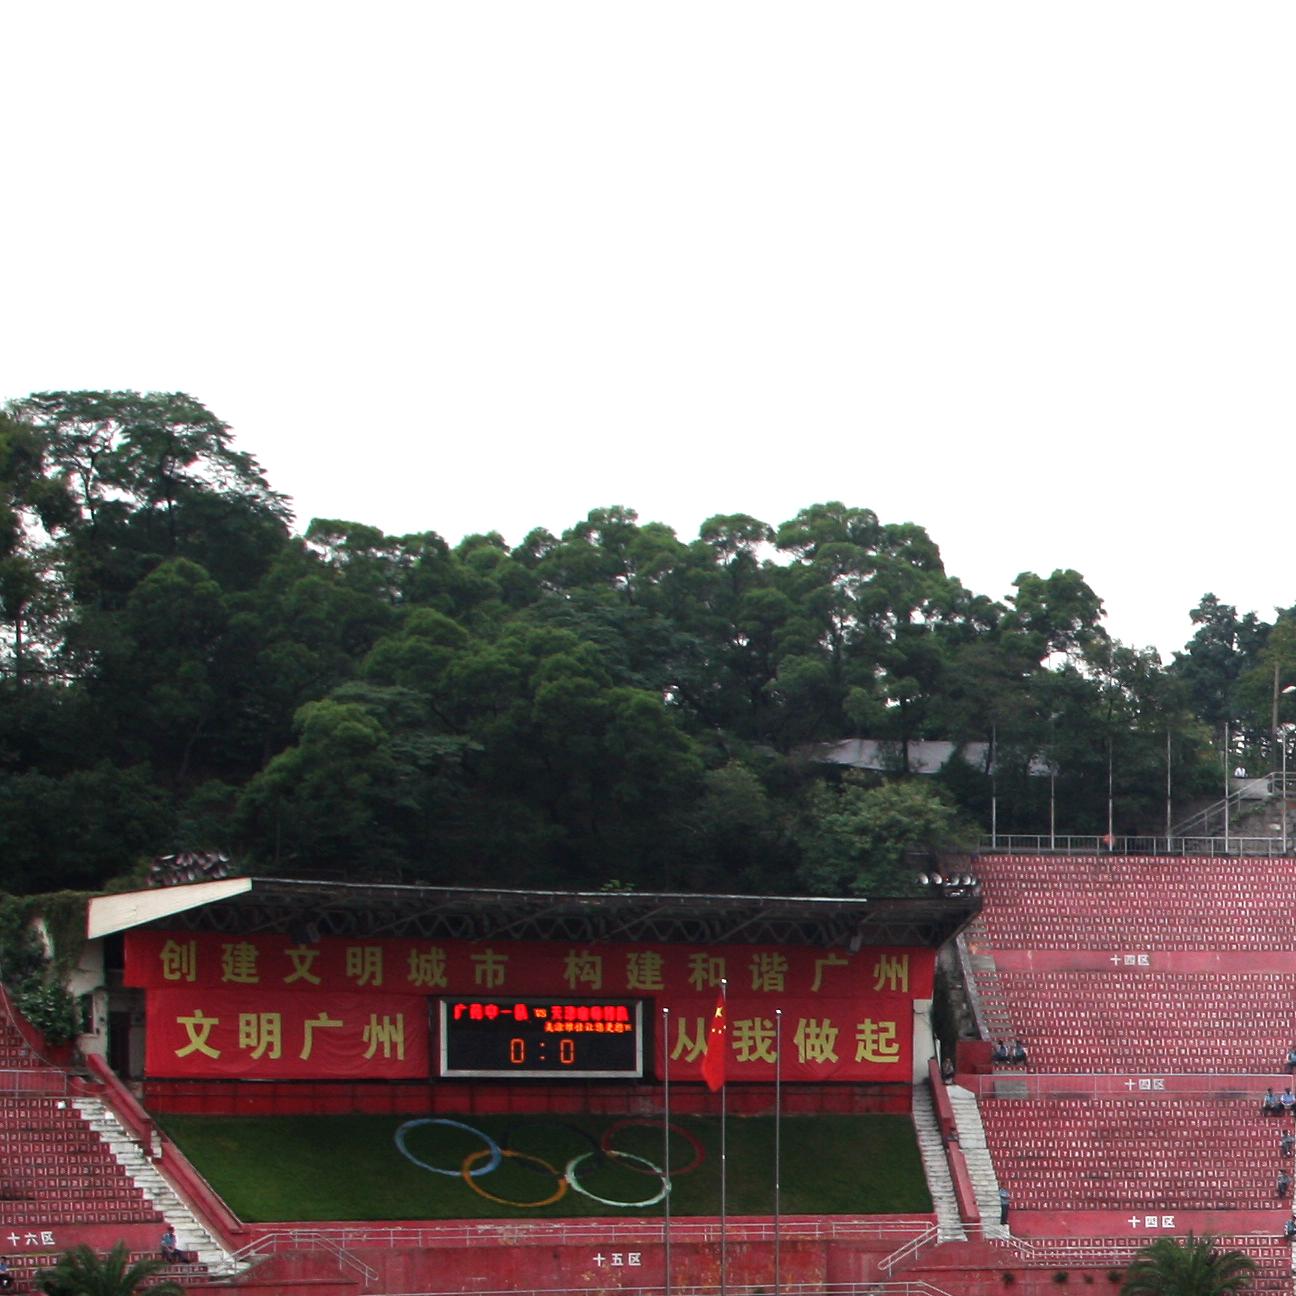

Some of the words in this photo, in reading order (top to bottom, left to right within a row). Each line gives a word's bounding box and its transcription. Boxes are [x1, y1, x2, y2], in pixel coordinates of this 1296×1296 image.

[160, 939, 509, 988] 创建文明城市
[564, 950, 909, 993] 构建和谐广州
[1110, 954, 1150, 967] 十四区
[174, 1009, 405, 1060] 文明广州
[670, 1017, 900, 1064] 从我做起
[1124, 1077, 1165, 1091] 十四区
[1127, 1215, 1176, 1229] 十四区
[7, 1231, 56, 1246] 十六区
[592, 1252, 642, 1267] 十五区
